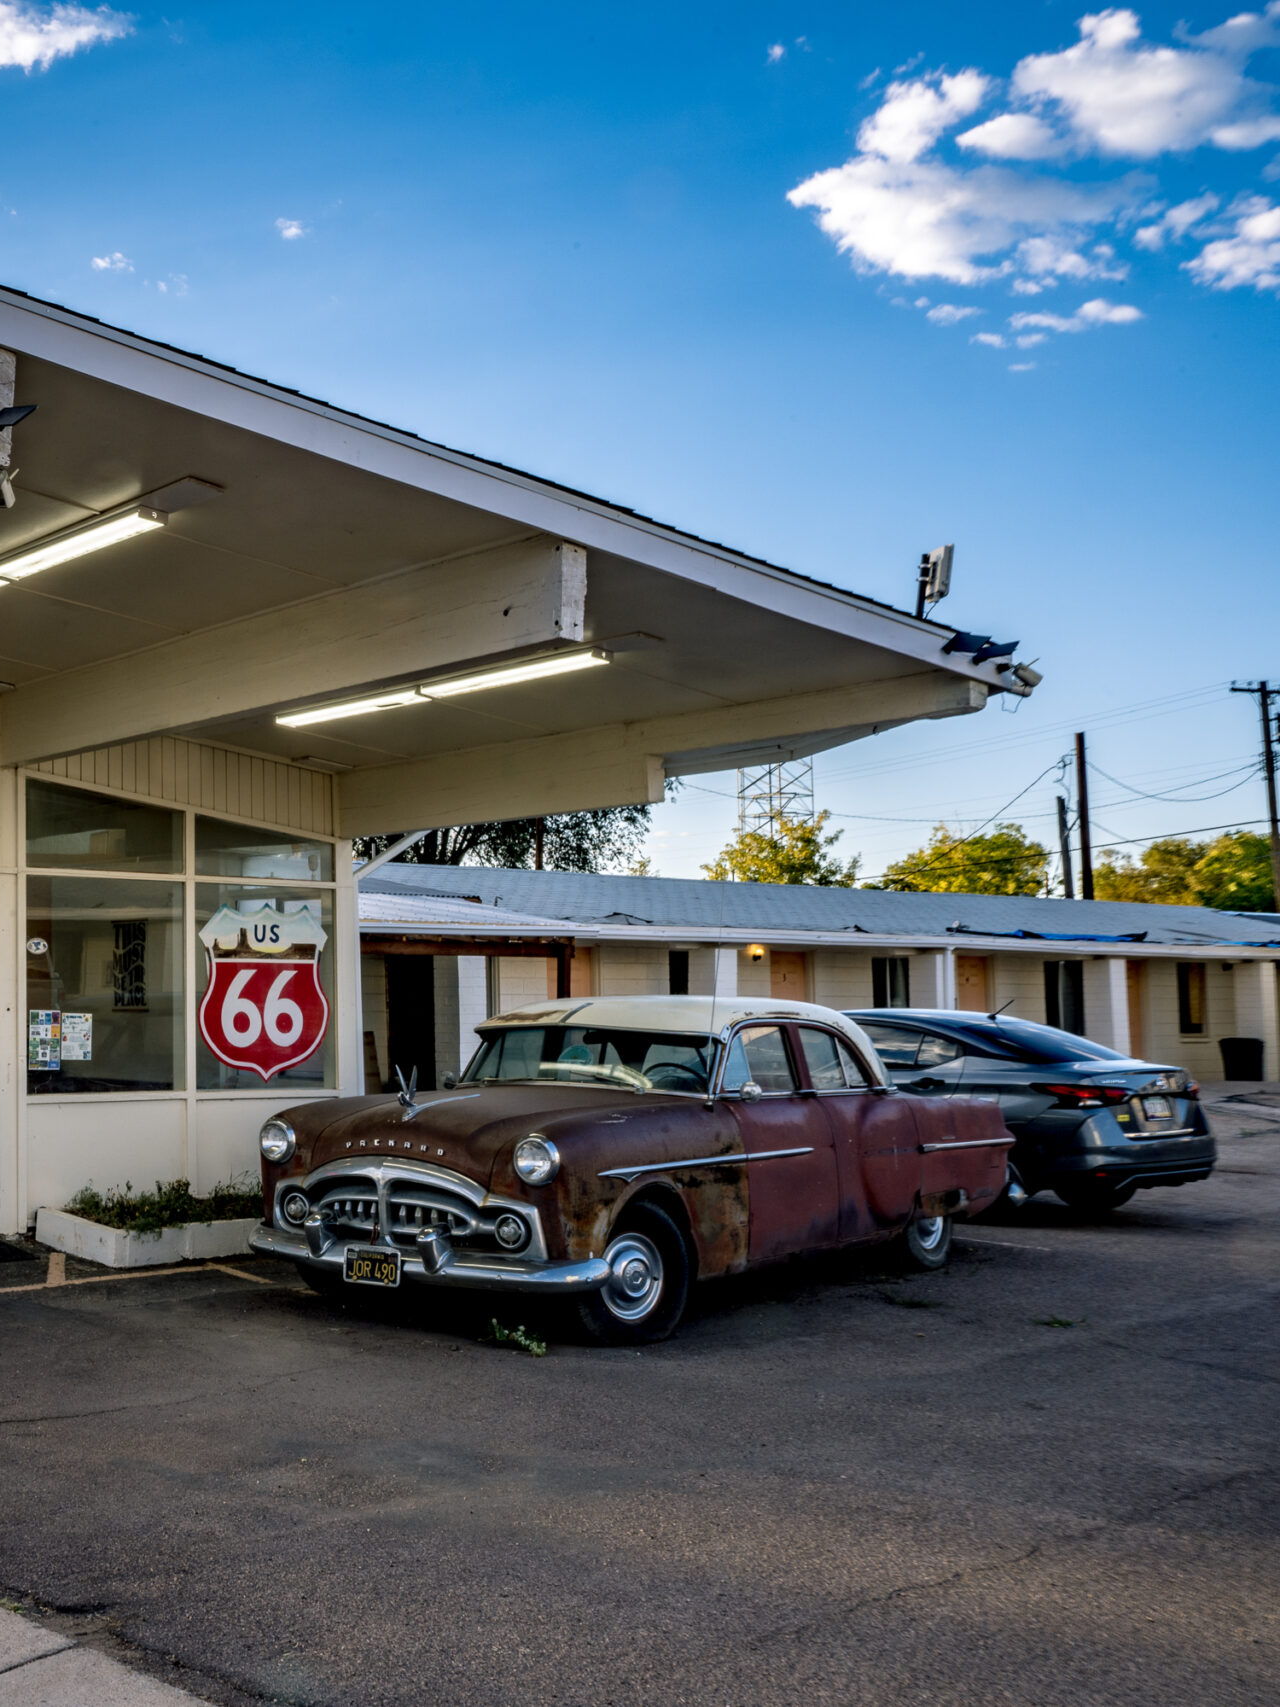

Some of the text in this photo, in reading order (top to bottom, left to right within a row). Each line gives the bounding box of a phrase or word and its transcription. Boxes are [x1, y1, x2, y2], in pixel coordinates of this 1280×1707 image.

[113, 922, 146, 950] THIS
[254, 924, 280, 944] US
[113, 943, 145, 974] MUST
[114, 985, 147, 1007] PLACE
[221, 969, 304, 1048] 66
[345, 1138, 444, 1156] PACKARD
[348, 1260, 396, 1281] JOR 490
